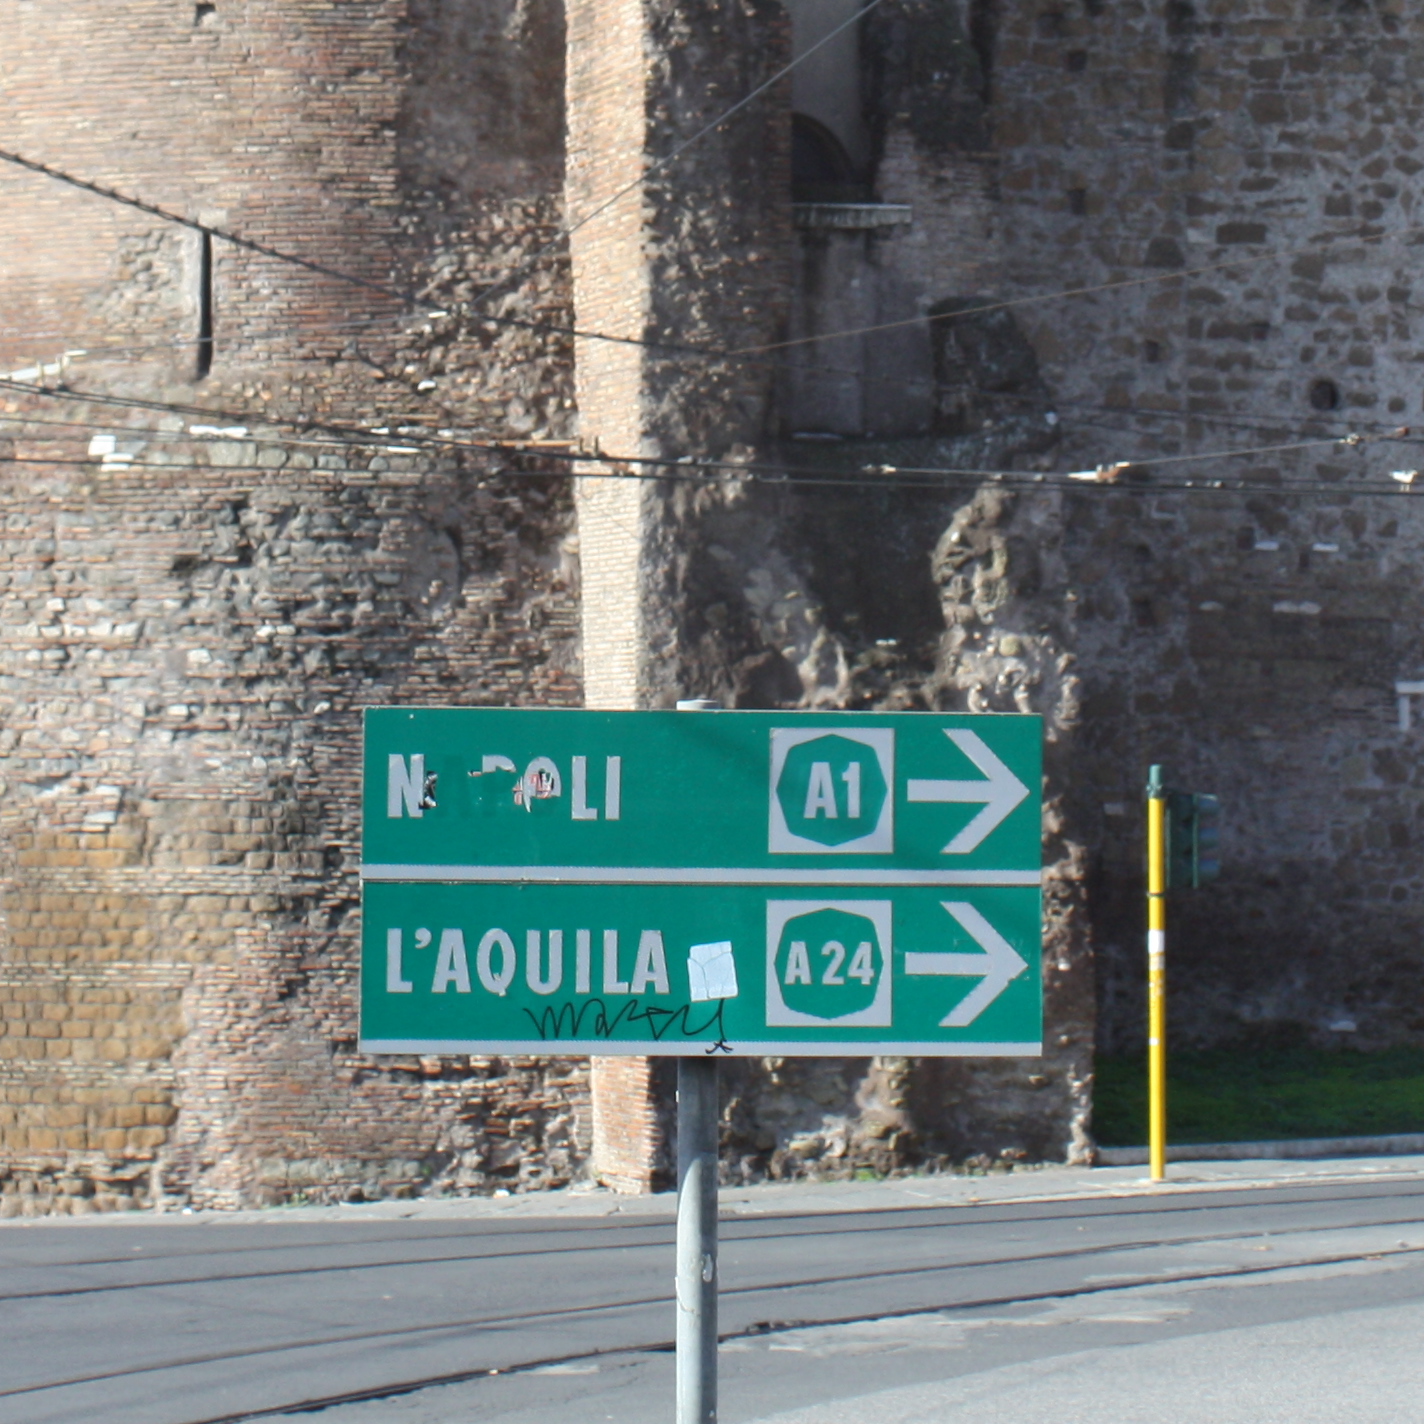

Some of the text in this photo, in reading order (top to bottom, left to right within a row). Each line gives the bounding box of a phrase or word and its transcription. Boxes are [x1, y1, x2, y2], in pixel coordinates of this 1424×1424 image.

[387, 752, 621, 821] NOLI
[803, 761, 861, 818] A1
[386, 927, 671, 996] L'AQUILA
